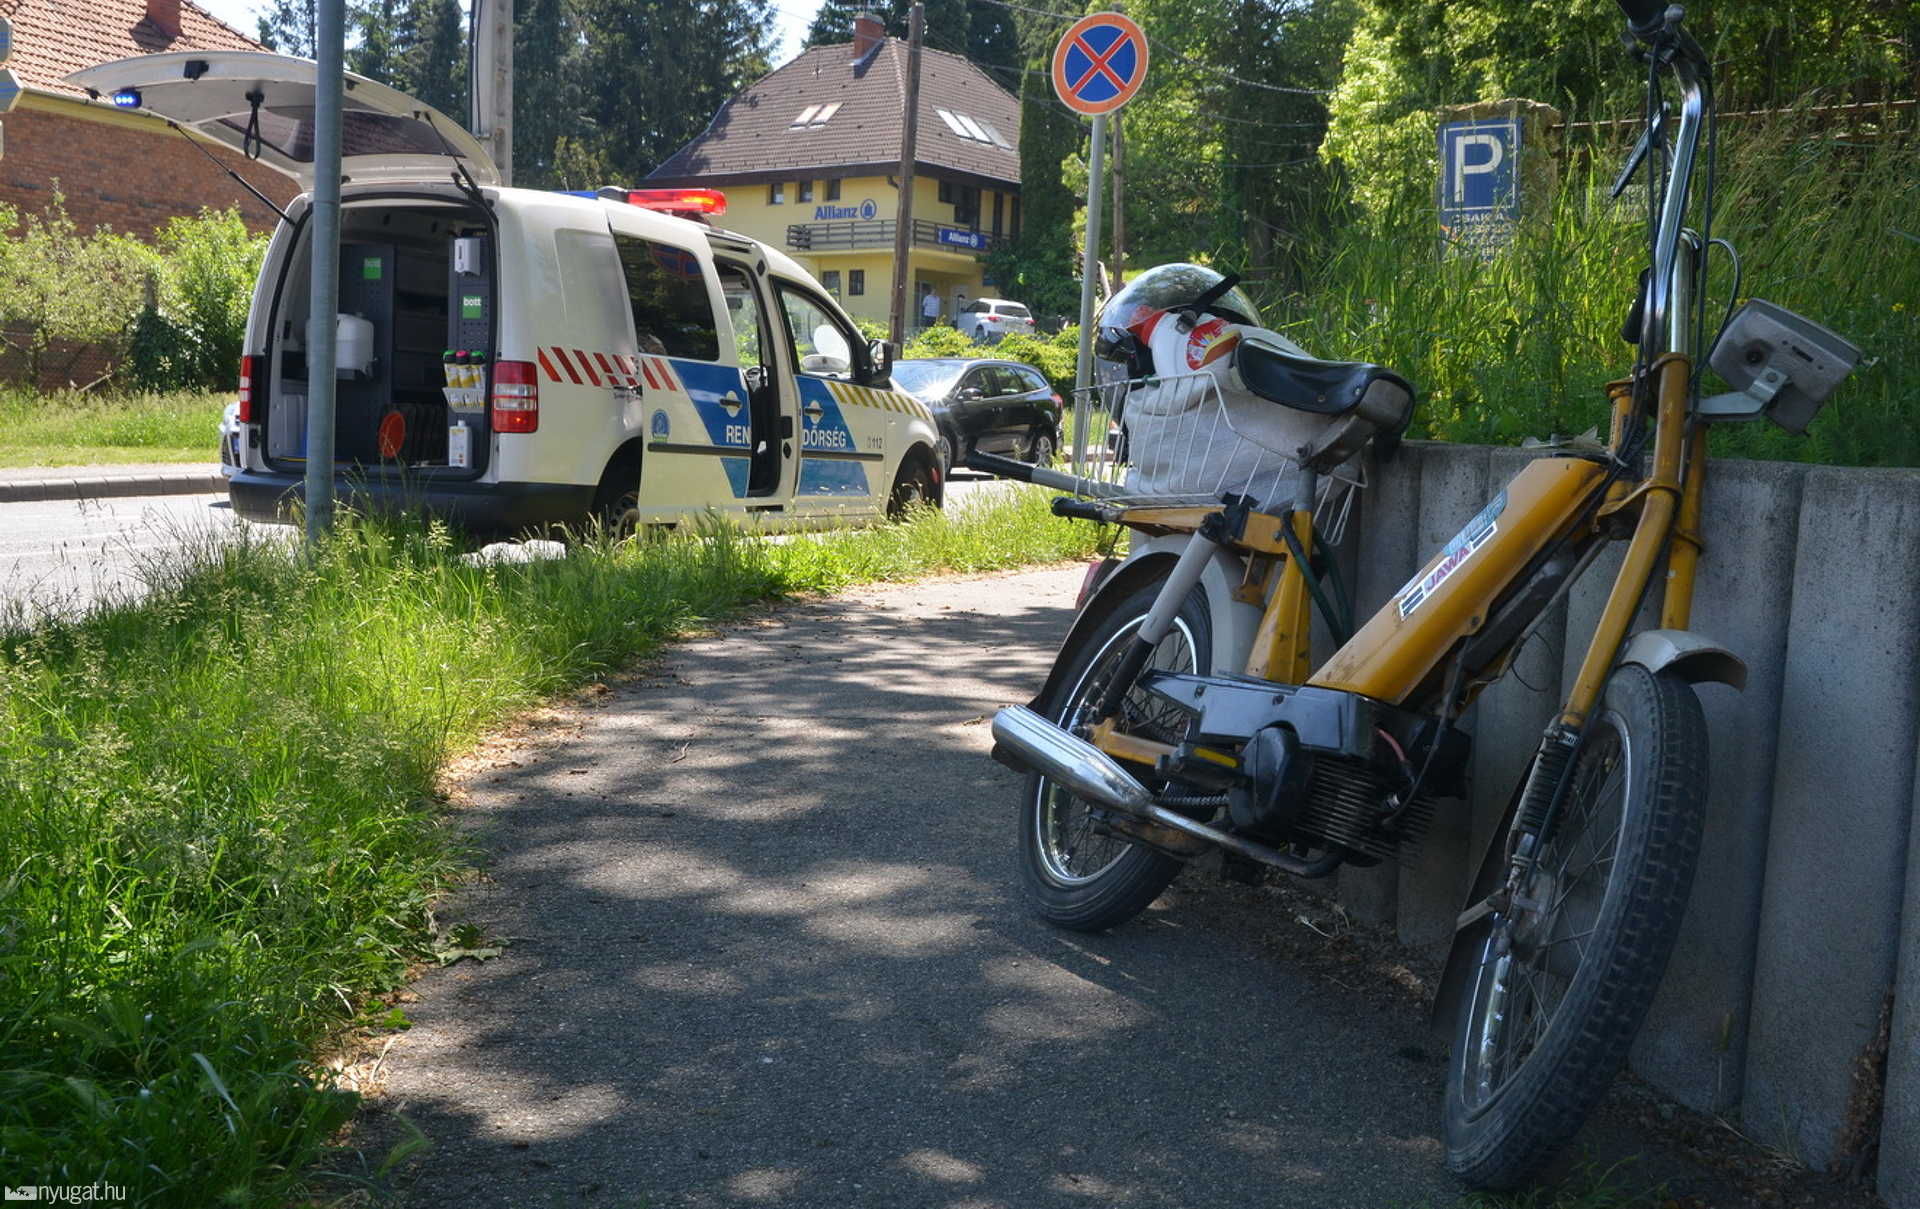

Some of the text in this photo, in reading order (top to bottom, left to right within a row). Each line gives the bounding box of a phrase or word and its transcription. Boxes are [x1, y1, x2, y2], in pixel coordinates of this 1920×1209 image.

[1454, 134, 1503, 203] P
[815, 205, 858, 220] Allianz
[463, 297, 481, 306] bott
[726, 424, 847, 448] REN DŐRSÉG
[1427, 545, 1471, 592] JAWA
